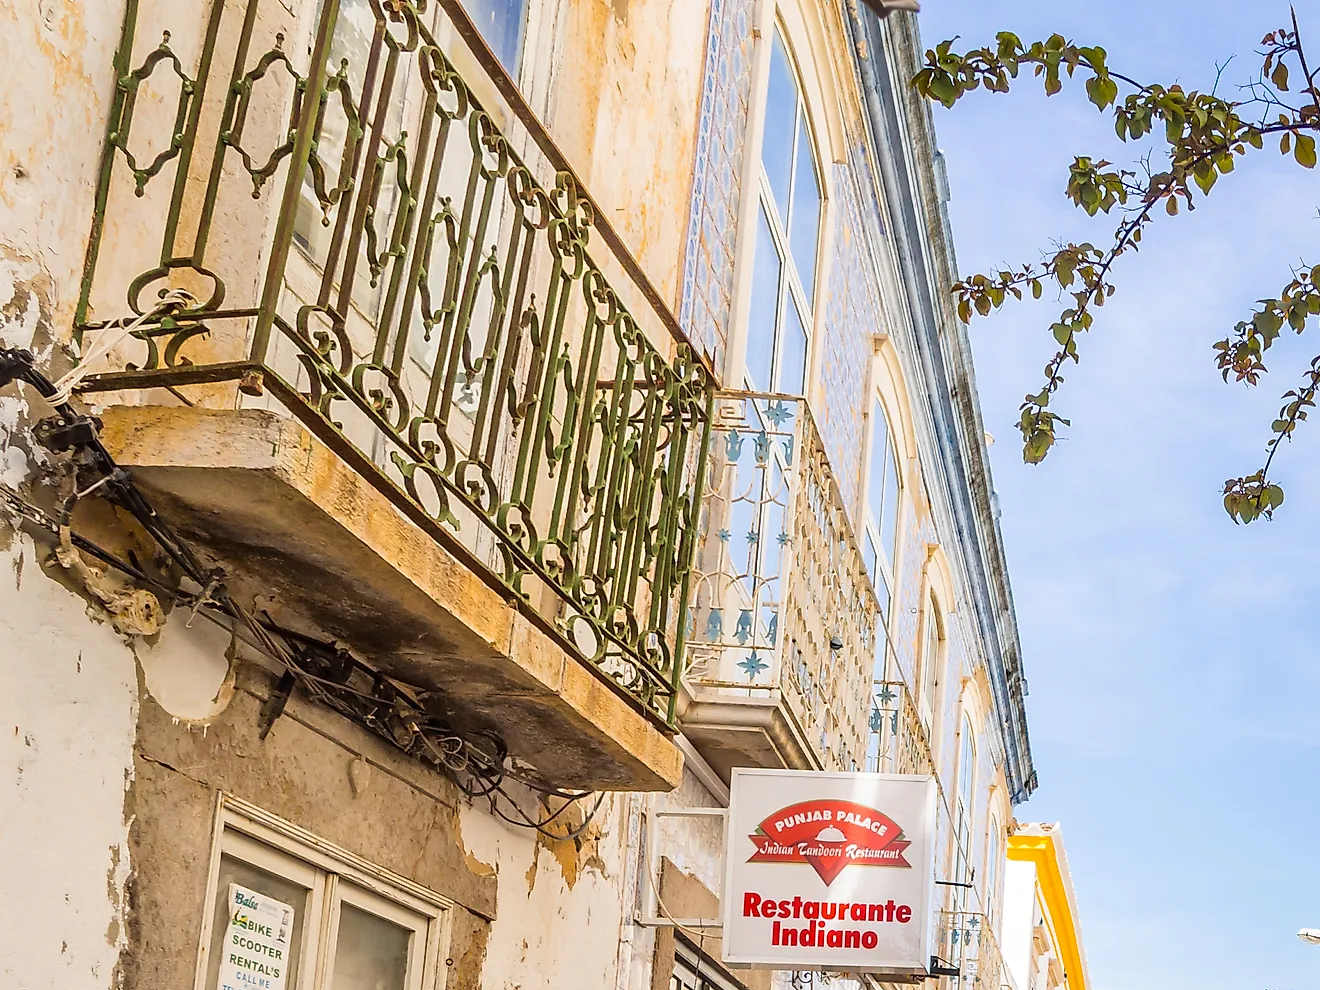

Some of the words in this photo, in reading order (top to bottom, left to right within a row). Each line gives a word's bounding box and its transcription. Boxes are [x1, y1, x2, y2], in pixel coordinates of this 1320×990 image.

[775, 809, 832, 832] PUNJAB
[836, 810, 887, 836] PALACE
[759, 841, 793, 855] Indian
[798, 843, 842, 857] Tandoori
[845, 844, 899, 859] Restaurant
[743, 892, 912, 923] Restaurante
[247, 920, 272, 938] BIKE
[772, 920, 878, 949] Indiano
[232, 935, 282, 960] SCOOTER
[230, 954, 280, 978] RENTAL'S
[236, 971, 257, 985] CALL
[259, 979, 270, 988] ME
